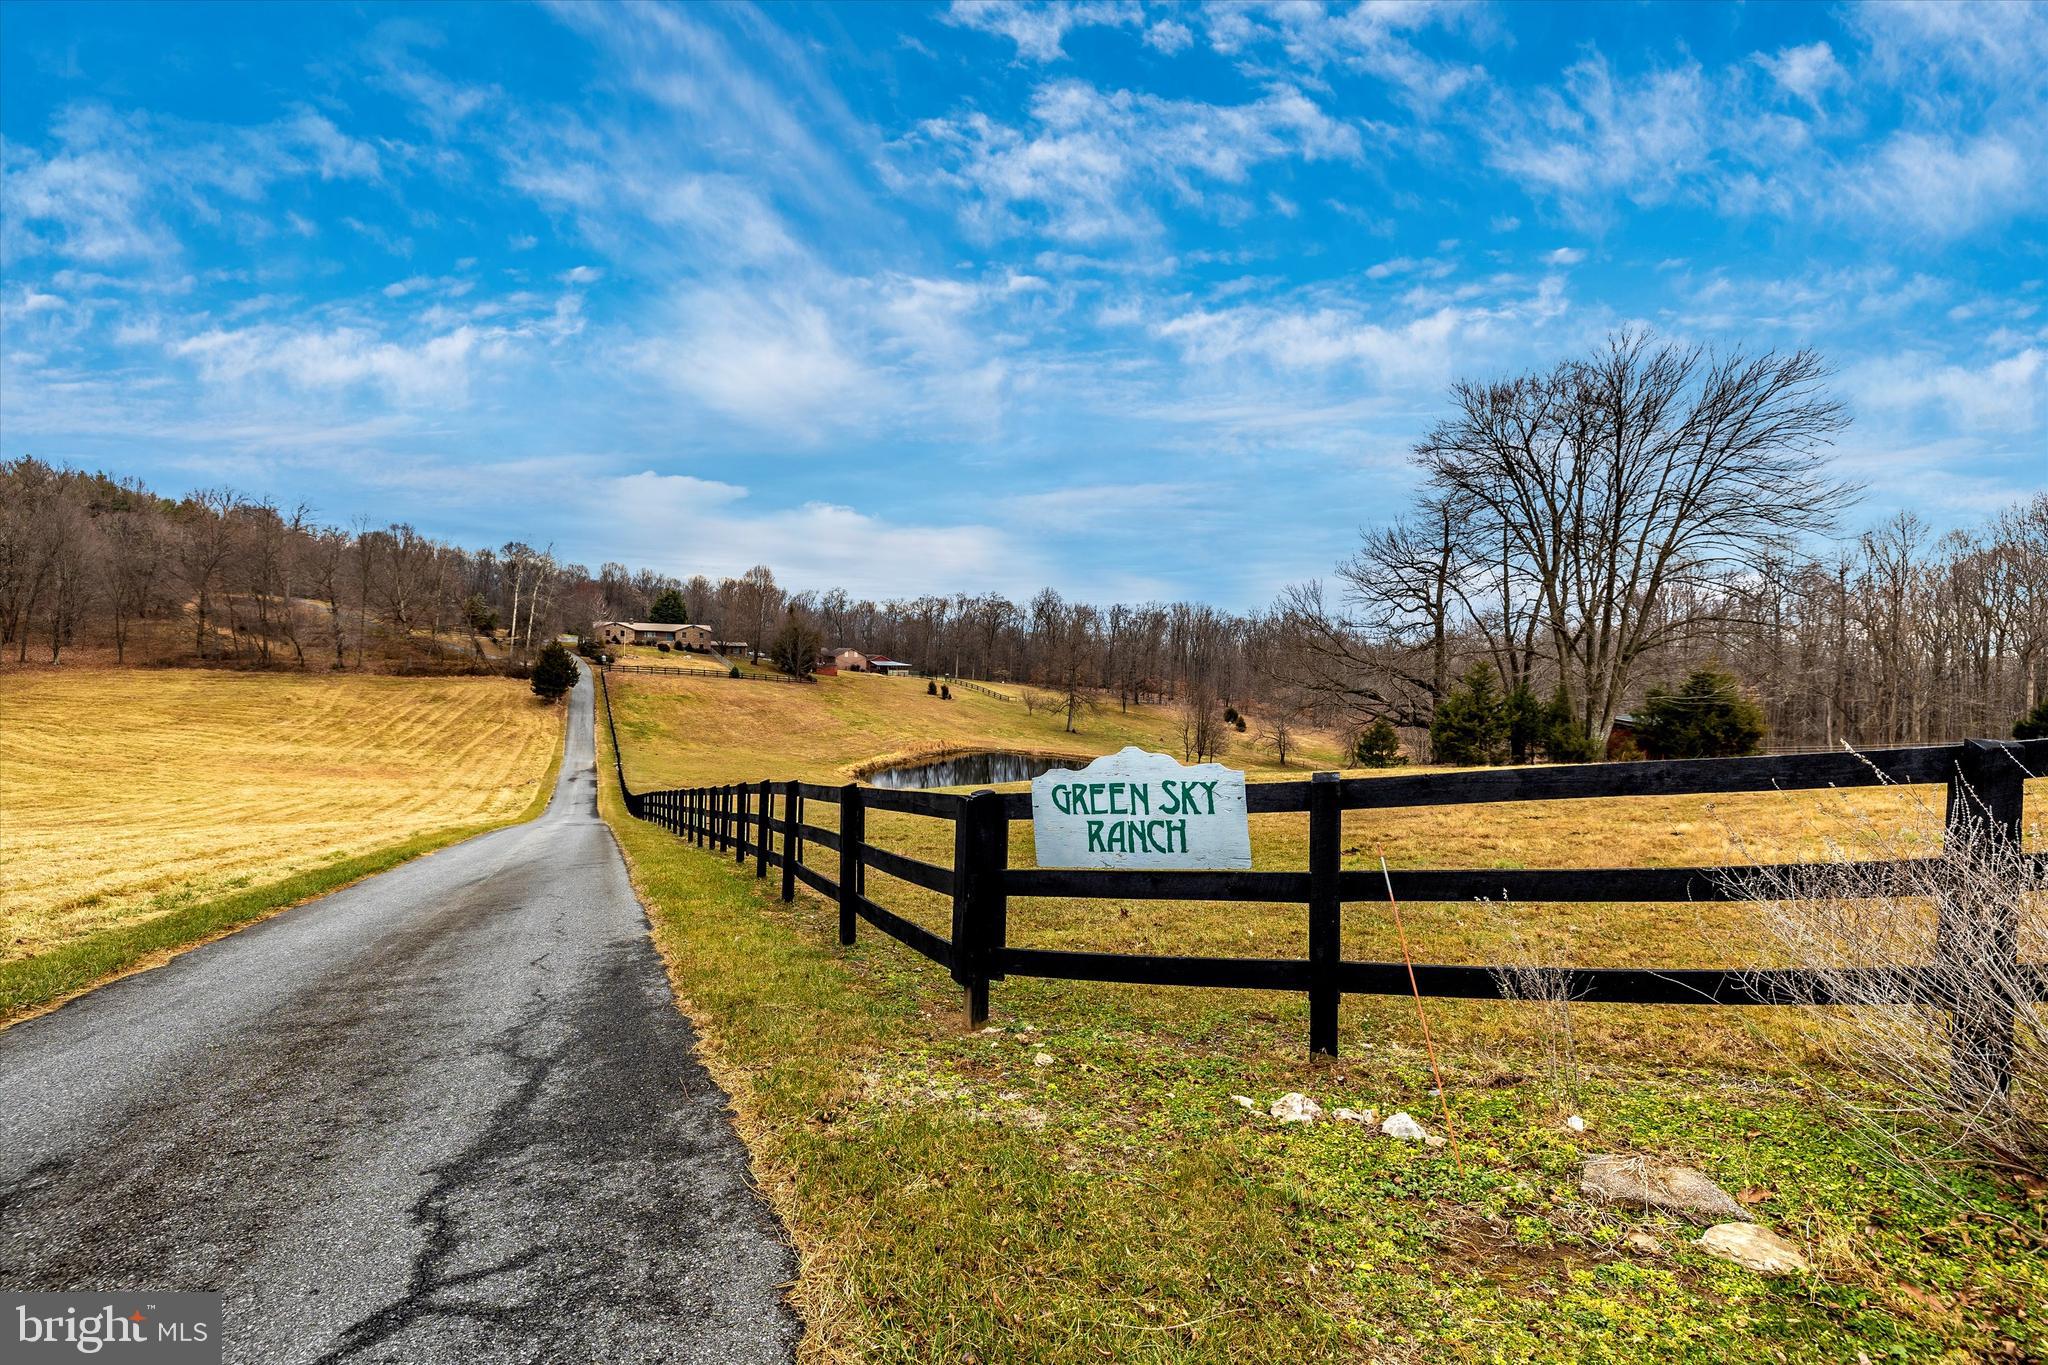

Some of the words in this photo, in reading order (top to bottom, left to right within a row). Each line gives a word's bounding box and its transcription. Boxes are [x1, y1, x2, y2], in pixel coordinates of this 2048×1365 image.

[1051, 783, 1150, 815] GREEN
[1158, 780, 1218, 815] SKY
[1086, 819, 1189, 854] RANCH
